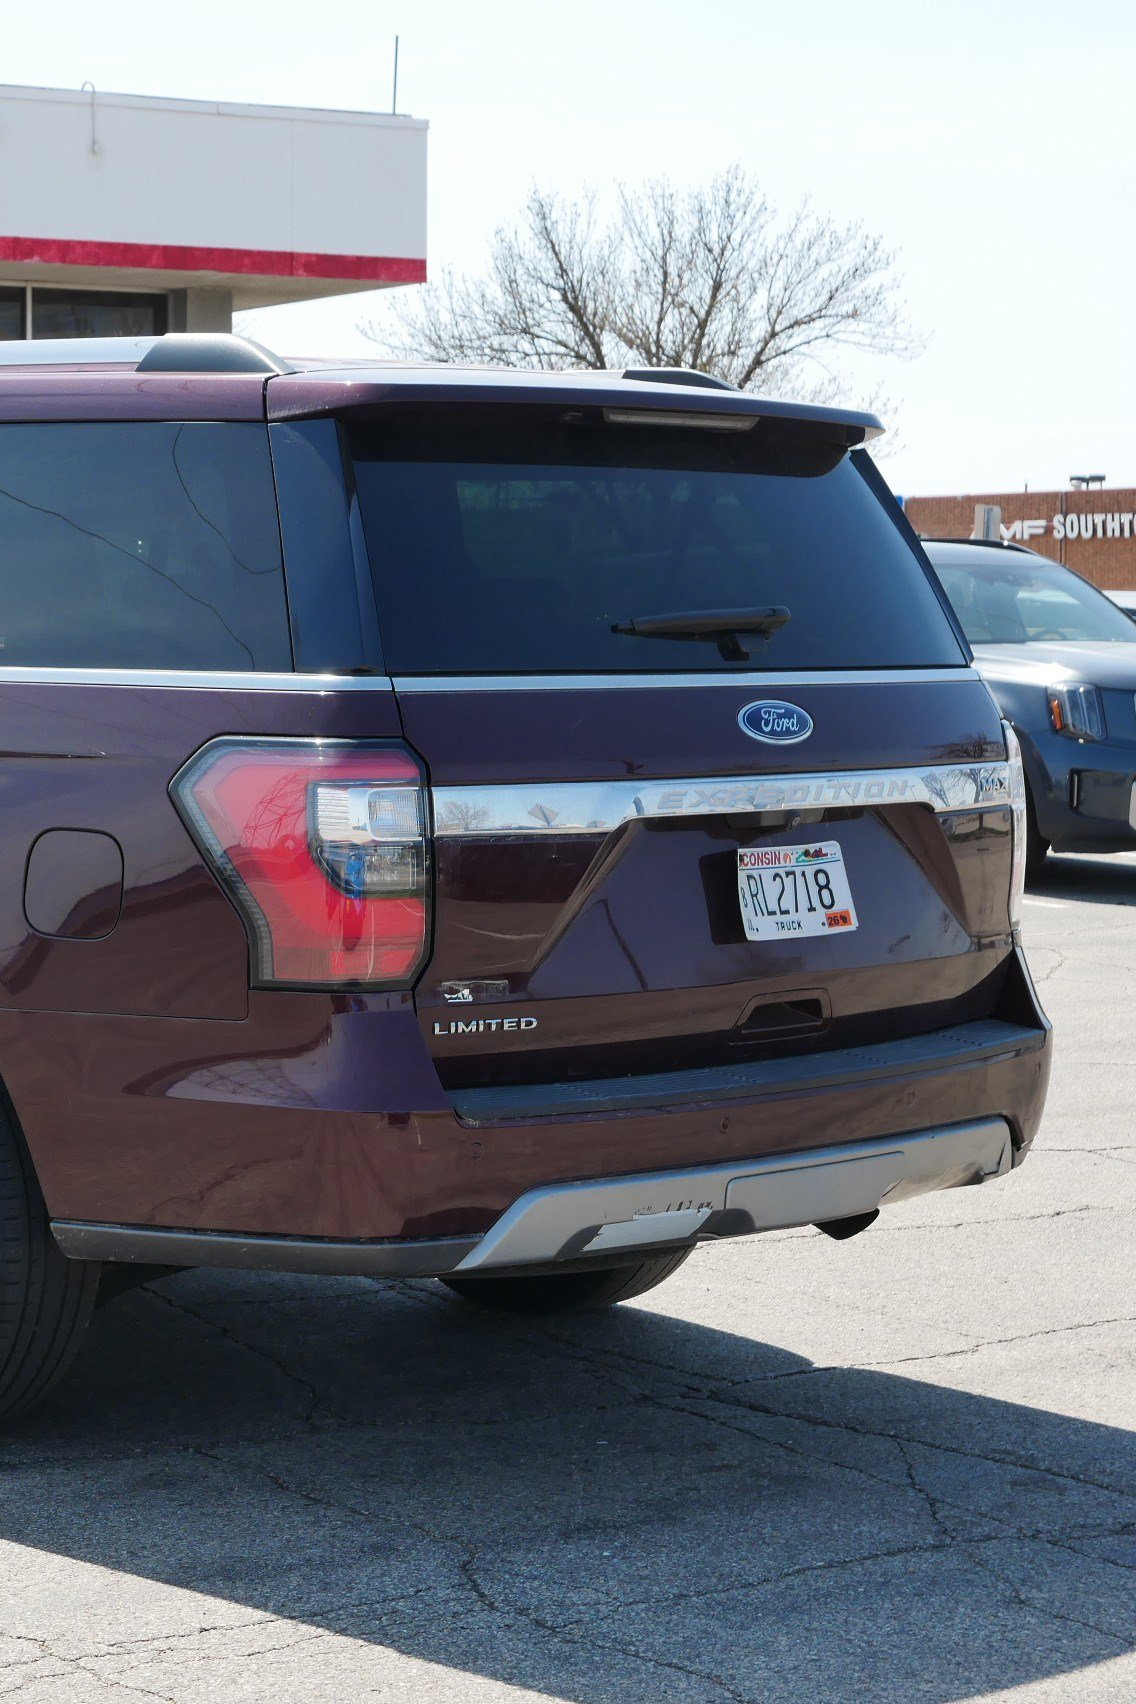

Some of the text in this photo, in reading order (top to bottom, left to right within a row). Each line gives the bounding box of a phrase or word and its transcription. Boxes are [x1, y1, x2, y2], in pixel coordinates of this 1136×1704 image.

[760, 707, 800, 732] Ford
[980, 777, 1007, 792] MAX
[657, 779, 909, 810] EXPEDITION
[739, 850, 781, 867] CONSIN
[746, 868, 836, 917] RL2718
[775, 920, 803, 932] TRUCK
[433, 1017, 538, 1035] LIMITED
